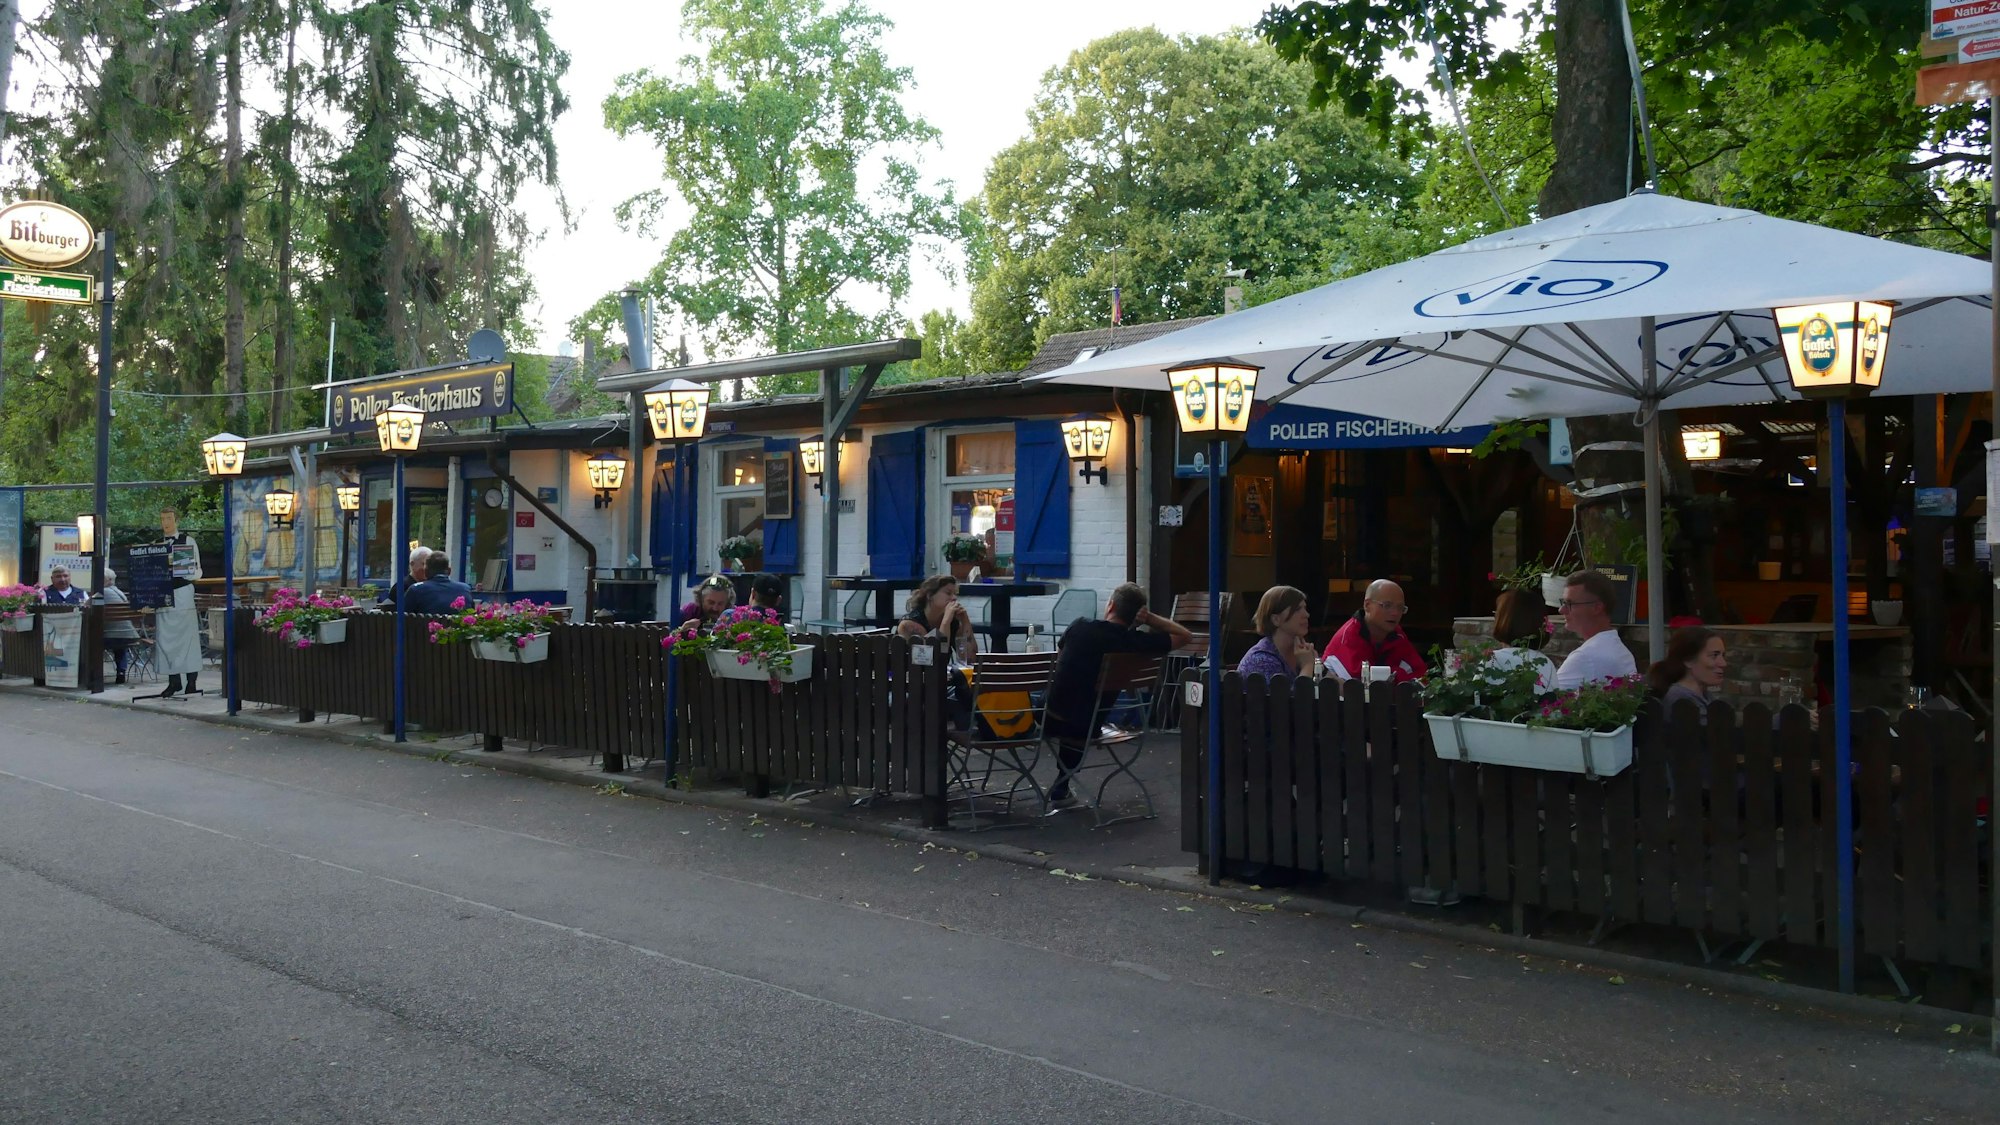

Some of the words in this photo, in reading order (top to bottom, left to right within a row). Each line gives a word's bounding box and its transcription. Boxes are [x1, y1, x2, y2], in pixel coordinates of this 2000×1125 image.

[9, 219, 80, 249] Bitburger
[14, 273, 42, 284] Poller
[1802, 336, 1836, 351] Gaffel
[350, 394, 389, 423] Poller
[392, 384, 482, 413] Fischerhaus
[1269, 422, 1329, 441] POLLER
[1335, 418, 1463, 438] FISCHERH
[129, 547, 148, 556] Gaffel
